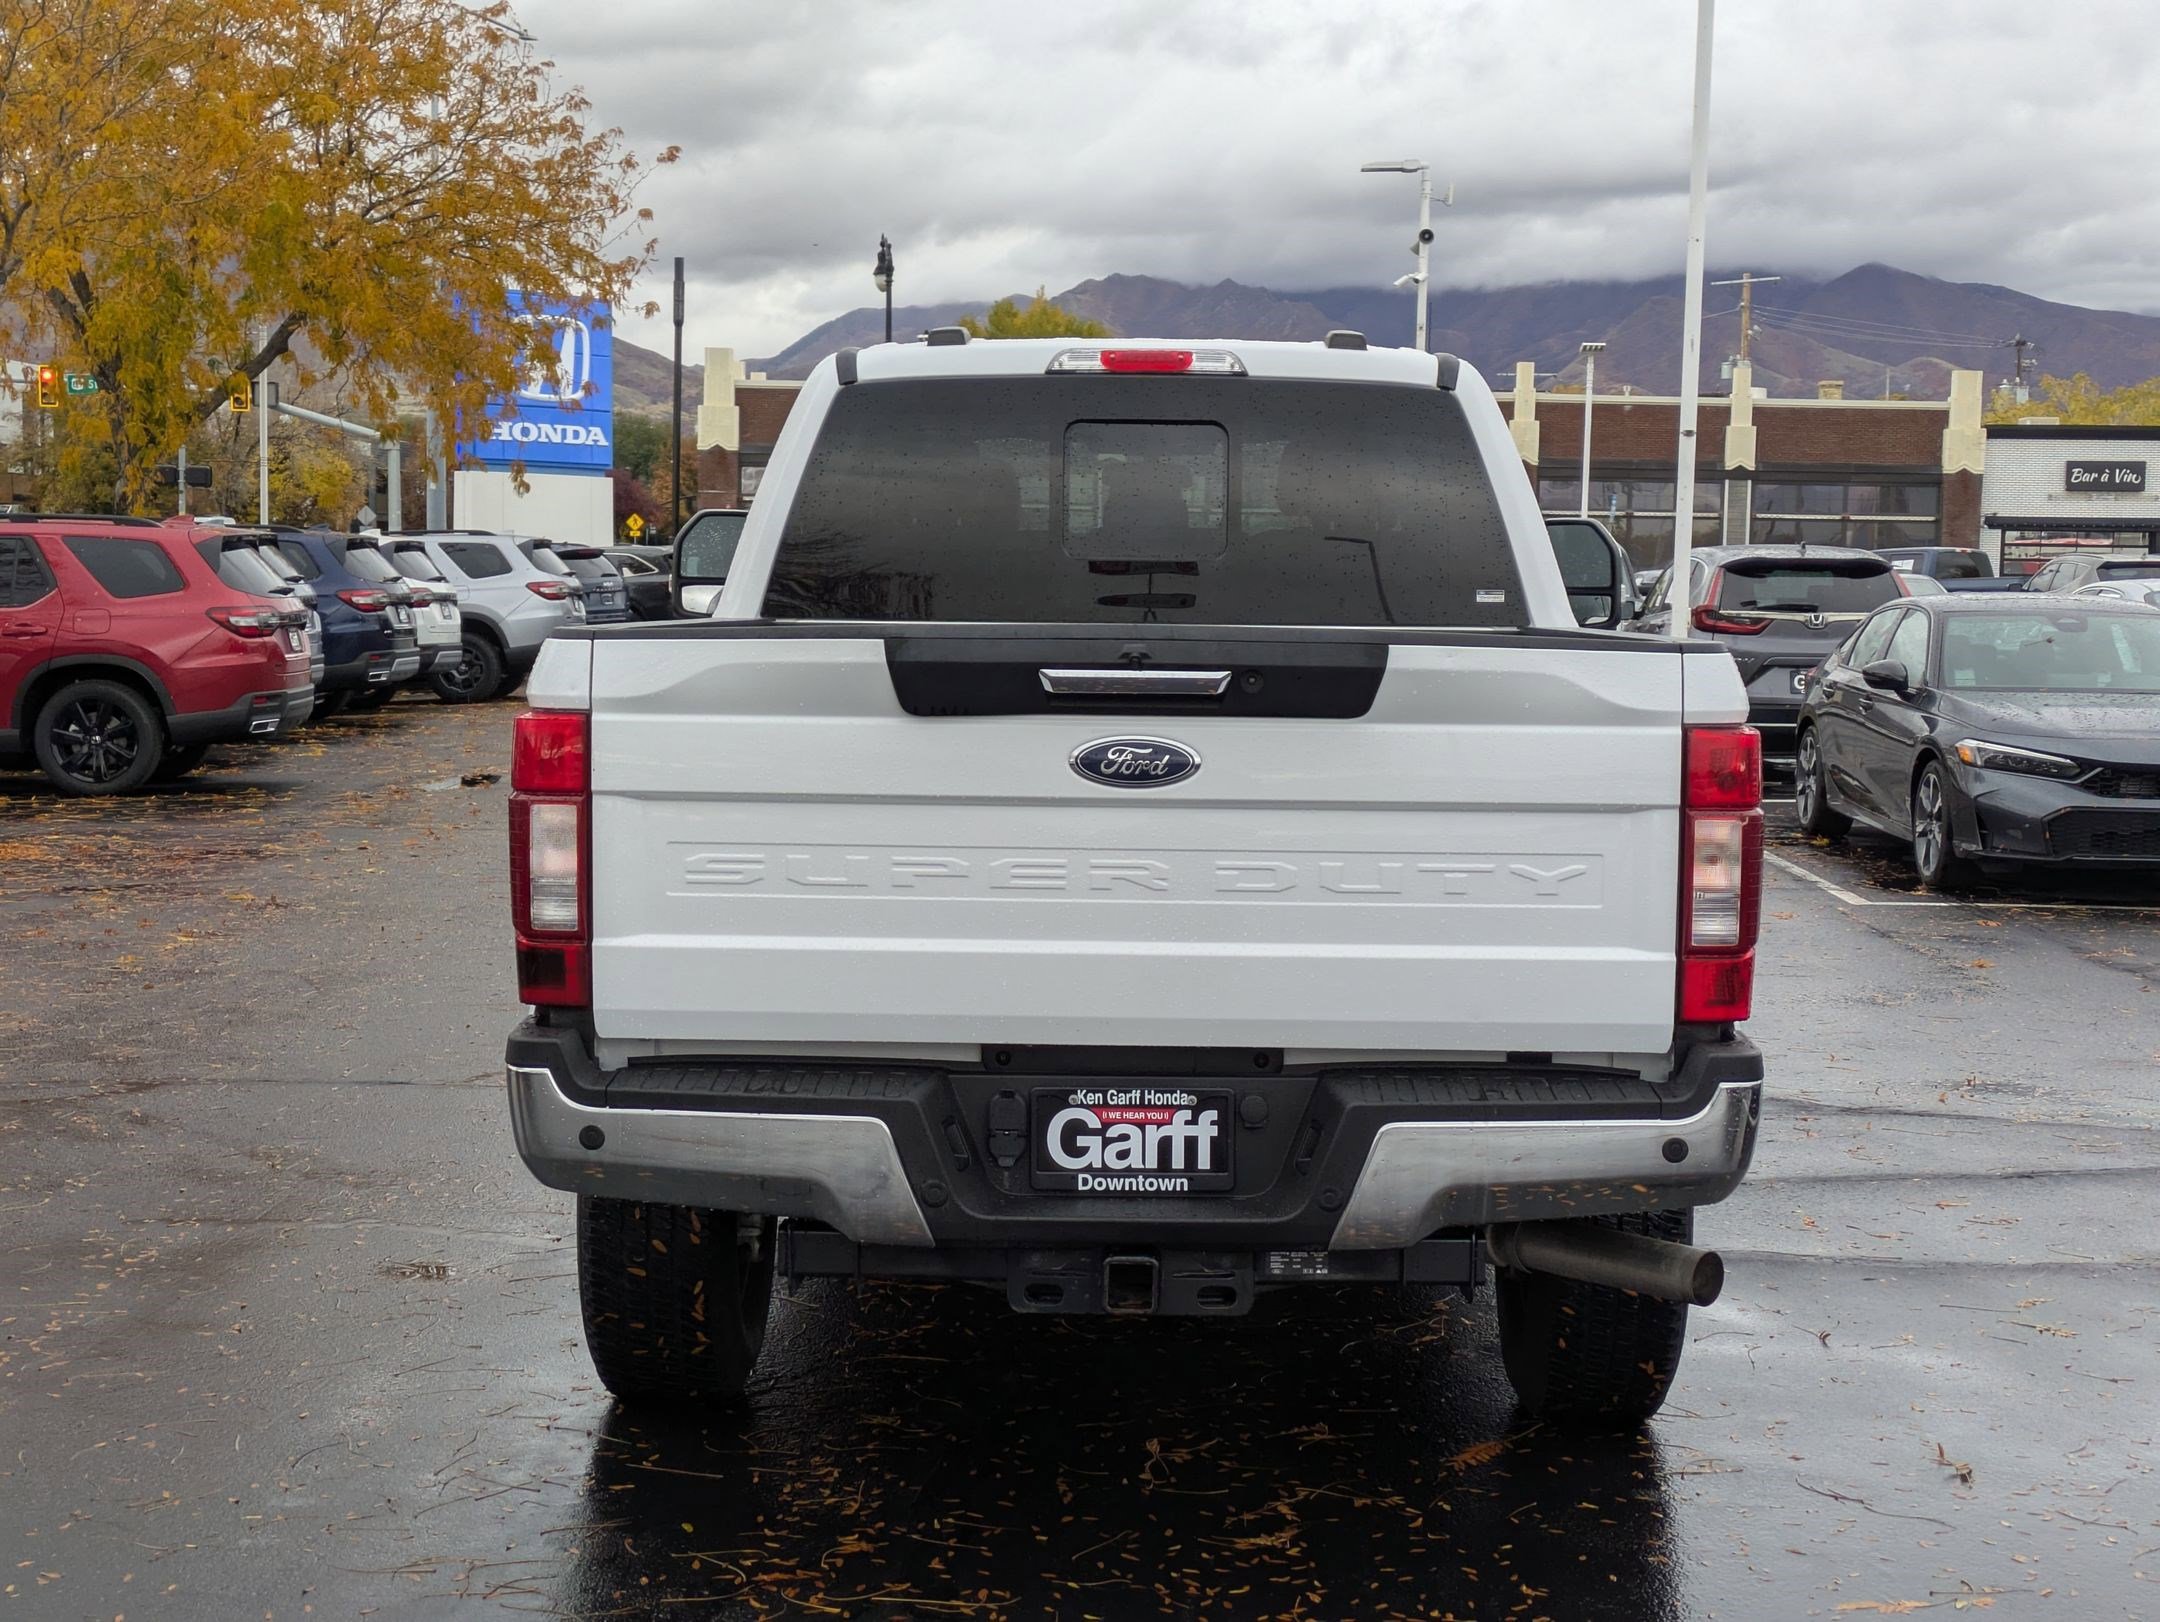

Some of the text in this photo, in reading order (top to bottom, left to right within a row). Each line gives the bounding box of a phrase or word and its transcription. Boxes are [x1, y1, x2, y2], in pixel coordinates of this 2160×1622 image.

[490, 421, 609, 446] HONDA
[2071, 468, 2142, 484] Bar à Vin
[1100, 746, 1171, 775] Ford
[685, 853, 1588, 896] SUPER DUTY
[1077, 1089, 1188, 1105] Ken Garff Honda
[1108, 1111, 1164, 1120] WE HEAR YOU
[1046, 1107, 1219, 1170] Garff
[1077, 1173, 1189, 1192] Downtown
